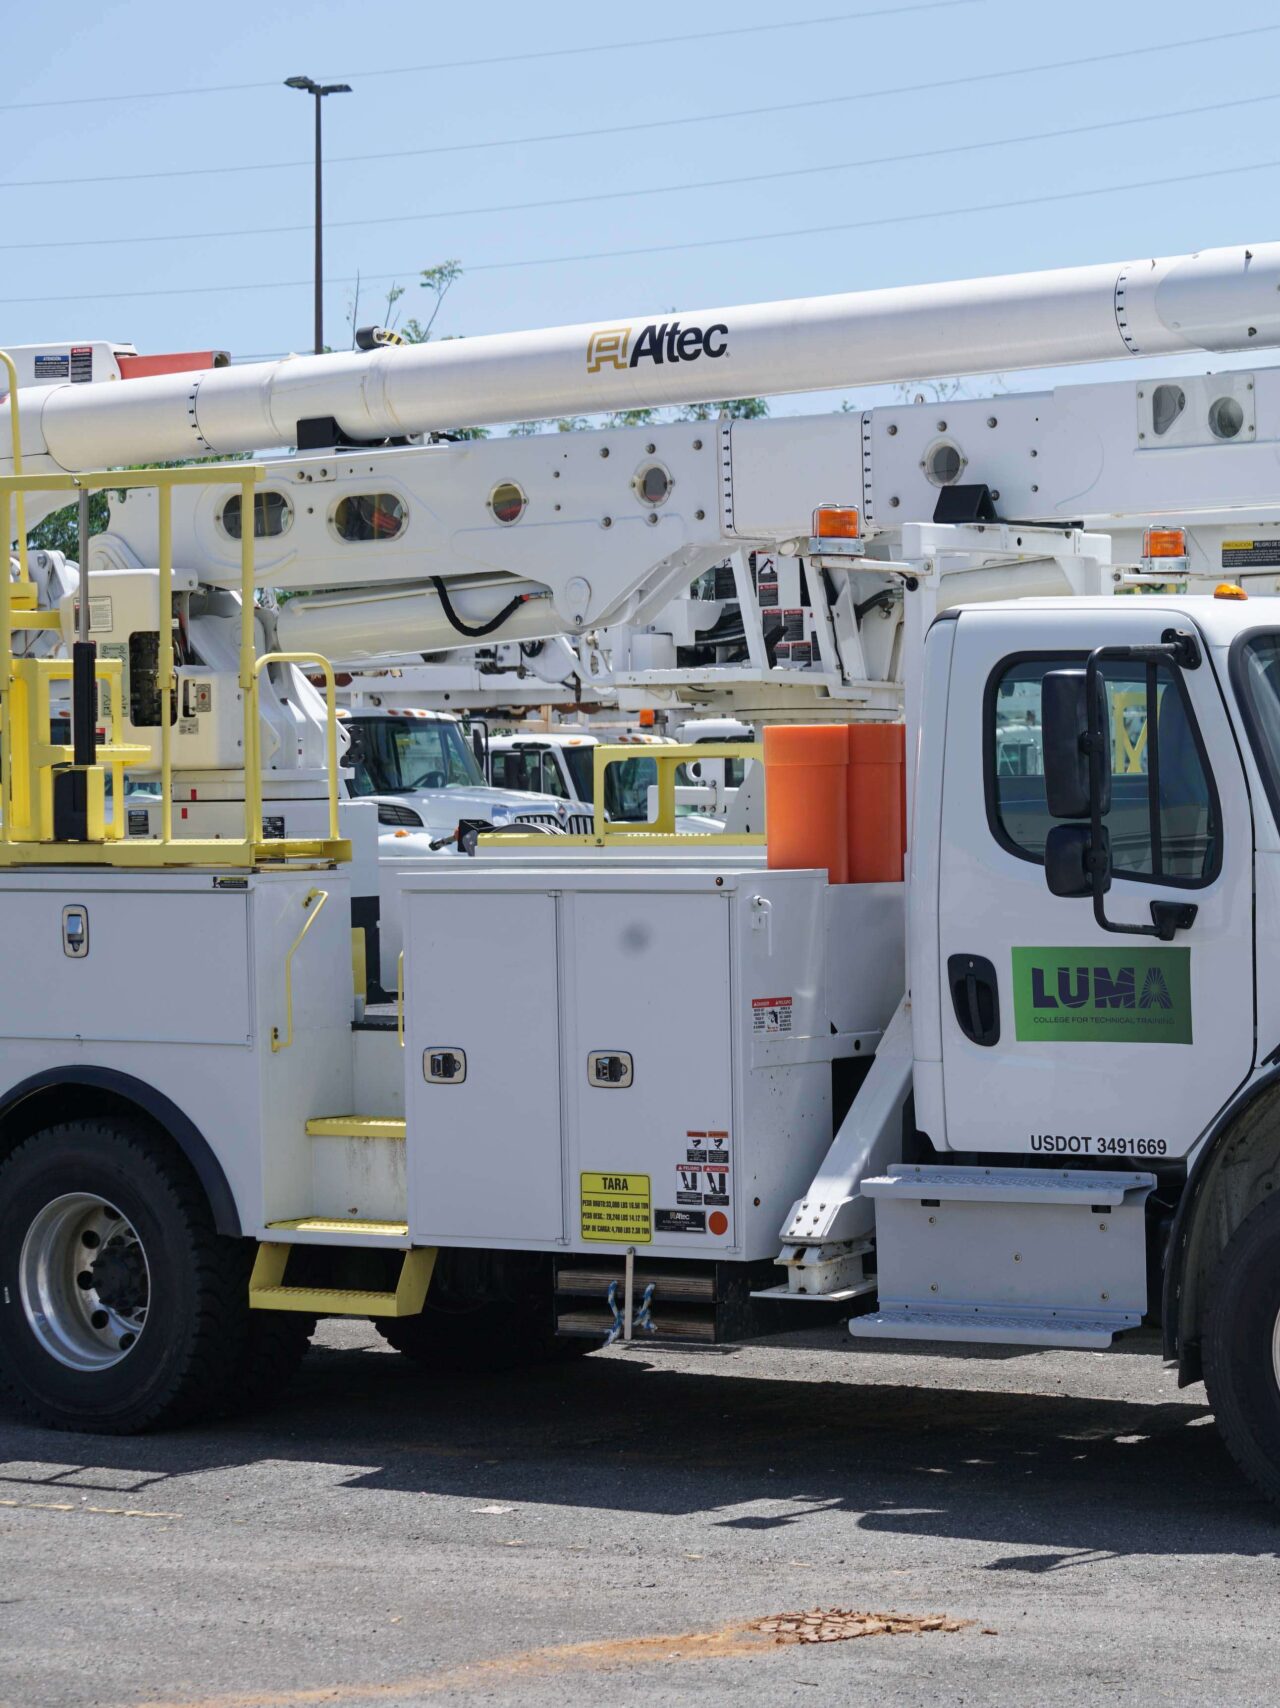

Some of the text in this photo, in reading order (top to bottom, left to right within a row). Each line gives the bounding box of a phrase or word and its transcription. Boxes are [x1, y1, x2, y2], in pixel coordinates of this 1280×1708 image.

[629, 321, 729, 368] Altec
[1032, 967, 1173, 1009] LUMA
[1033, 1016, 1070, 1024] COLLEGE
[1091, 1017, 1134, 1025] TECHNICAL
[1137, 1018, 1175, 1026] TRAINING
[1030, 1135, 1167, 1155] USDOT 3491669
[602, 1177, 629, 1191] TARA
[583, 1212, 592, 1220] PESO
[675, 1212, 690, 1220] Altec
